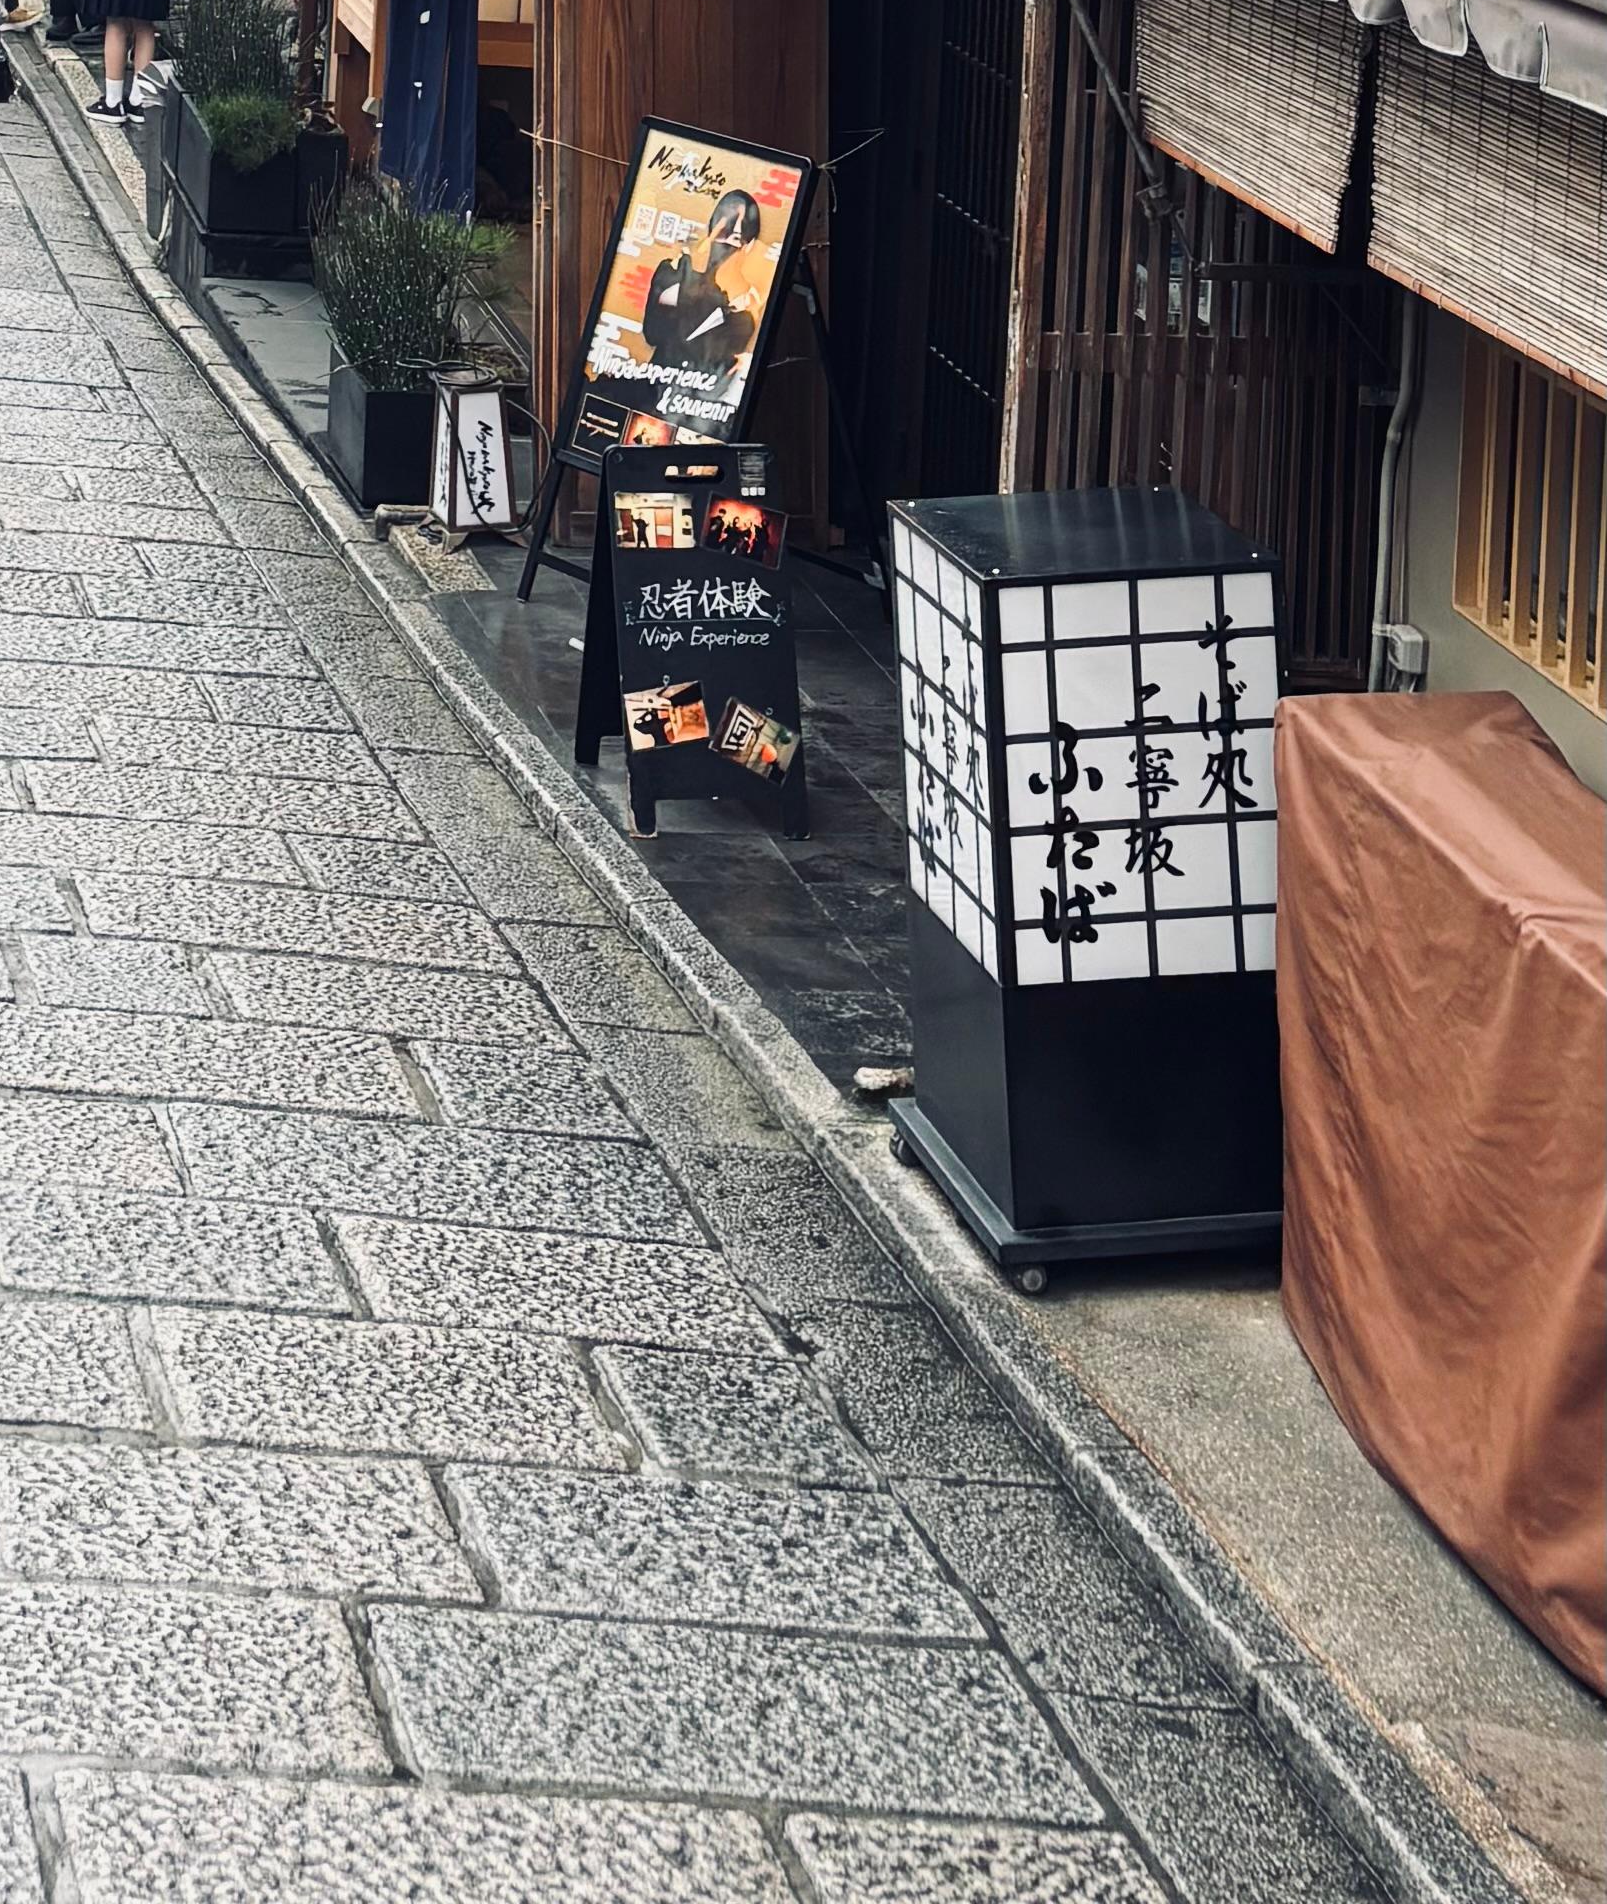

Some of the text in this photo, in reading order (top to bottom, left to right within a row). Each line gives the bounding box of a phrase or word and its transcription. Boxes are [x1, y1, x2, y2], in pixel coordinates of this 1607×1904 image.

[670, 394, 736, 422] souvenir
[639, 577, 772, 619] 忍者体験
[639, 625, 770, 652] Ninja Experience
[1198, 615, 1258, 808] そば処
[1028, 721, 1117, 943] ふたば
